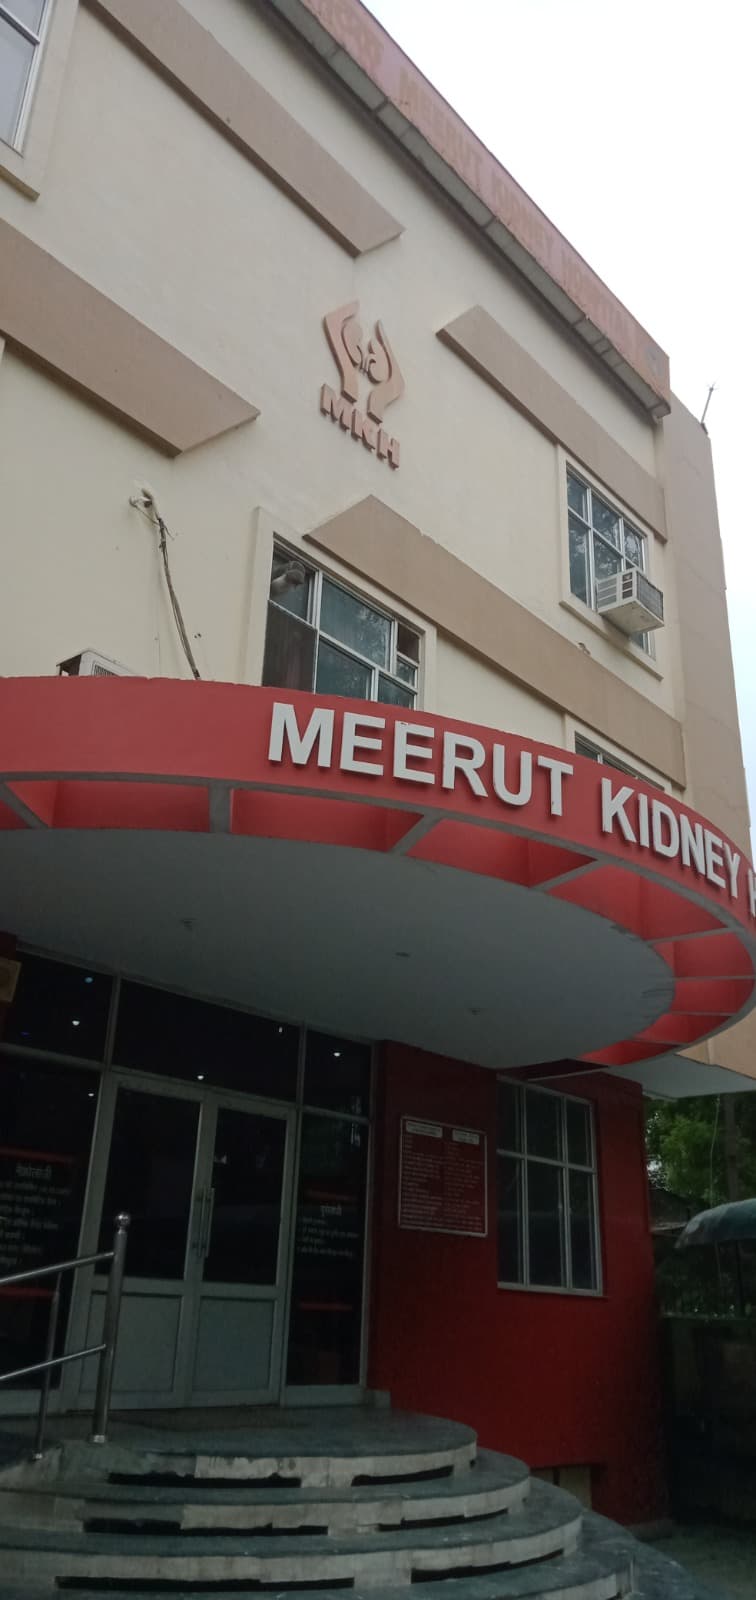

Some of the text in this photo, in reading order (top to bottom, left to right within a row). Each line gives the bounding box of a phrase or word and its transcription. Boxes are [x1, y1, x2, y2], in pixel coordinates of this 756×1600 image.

[319, 384, 401, 470] MKH
[268, 702, 574, 817] MEERUT
[600, 777, 740, 899] KIDNEY
